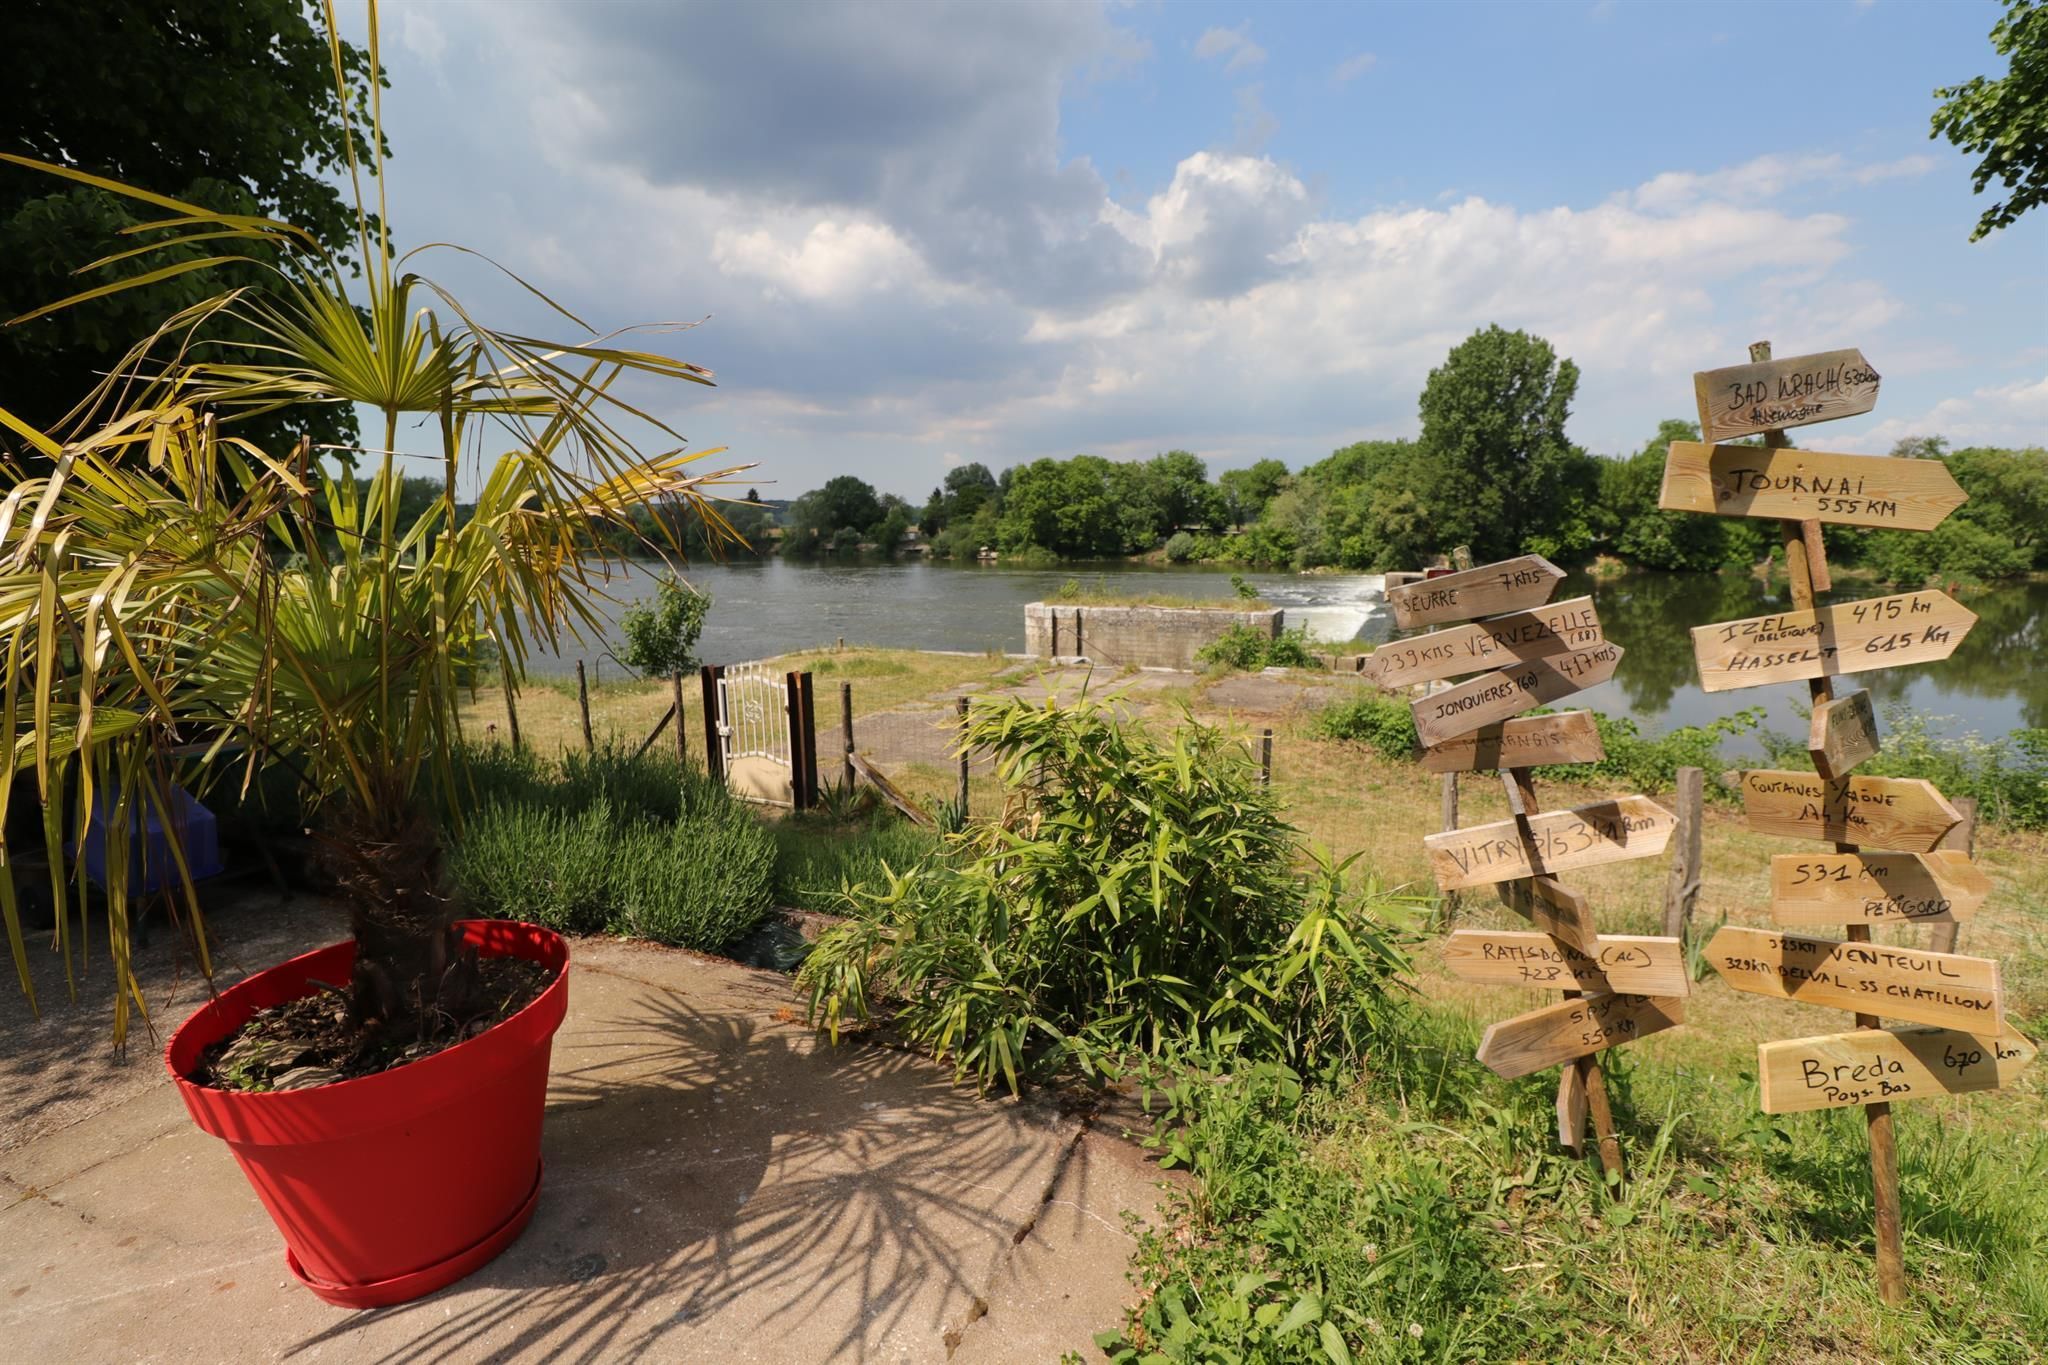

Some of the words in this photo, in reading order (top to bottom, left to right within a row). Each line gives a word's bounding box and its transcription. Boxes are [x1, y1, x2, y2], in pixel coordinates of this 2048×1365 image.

[1728, 380, 1768, 410] BAD
[1818, 497, 1858, 513] 555
[1865, 502, 1896, 517] KM
[1402, 588, 1458, 612] SEURRE
[1464, 609, 1598, 657] VERVEZELLE
[1719, 616, 1796, 643] IZEL
[1852, 599, 1903, 624] 415
[1727, 647, 1838, 671] HASSELT
[1864, 633, 1913, 653] 615
[1517, 671, 1540, 692] (60)
[1791, 864, 1851, 885] 531
[1829, 949, 1961, 978] VENTEUIL
[1859, 980, 1879, 993] SS
[1886, 984, 1993, 1011] CHATILLON
[1569, 999, 1612, 1025] SPY
[1801, 1055, 1904, 1089] Breda
[1943, 1045, 1982, 1076] 670
